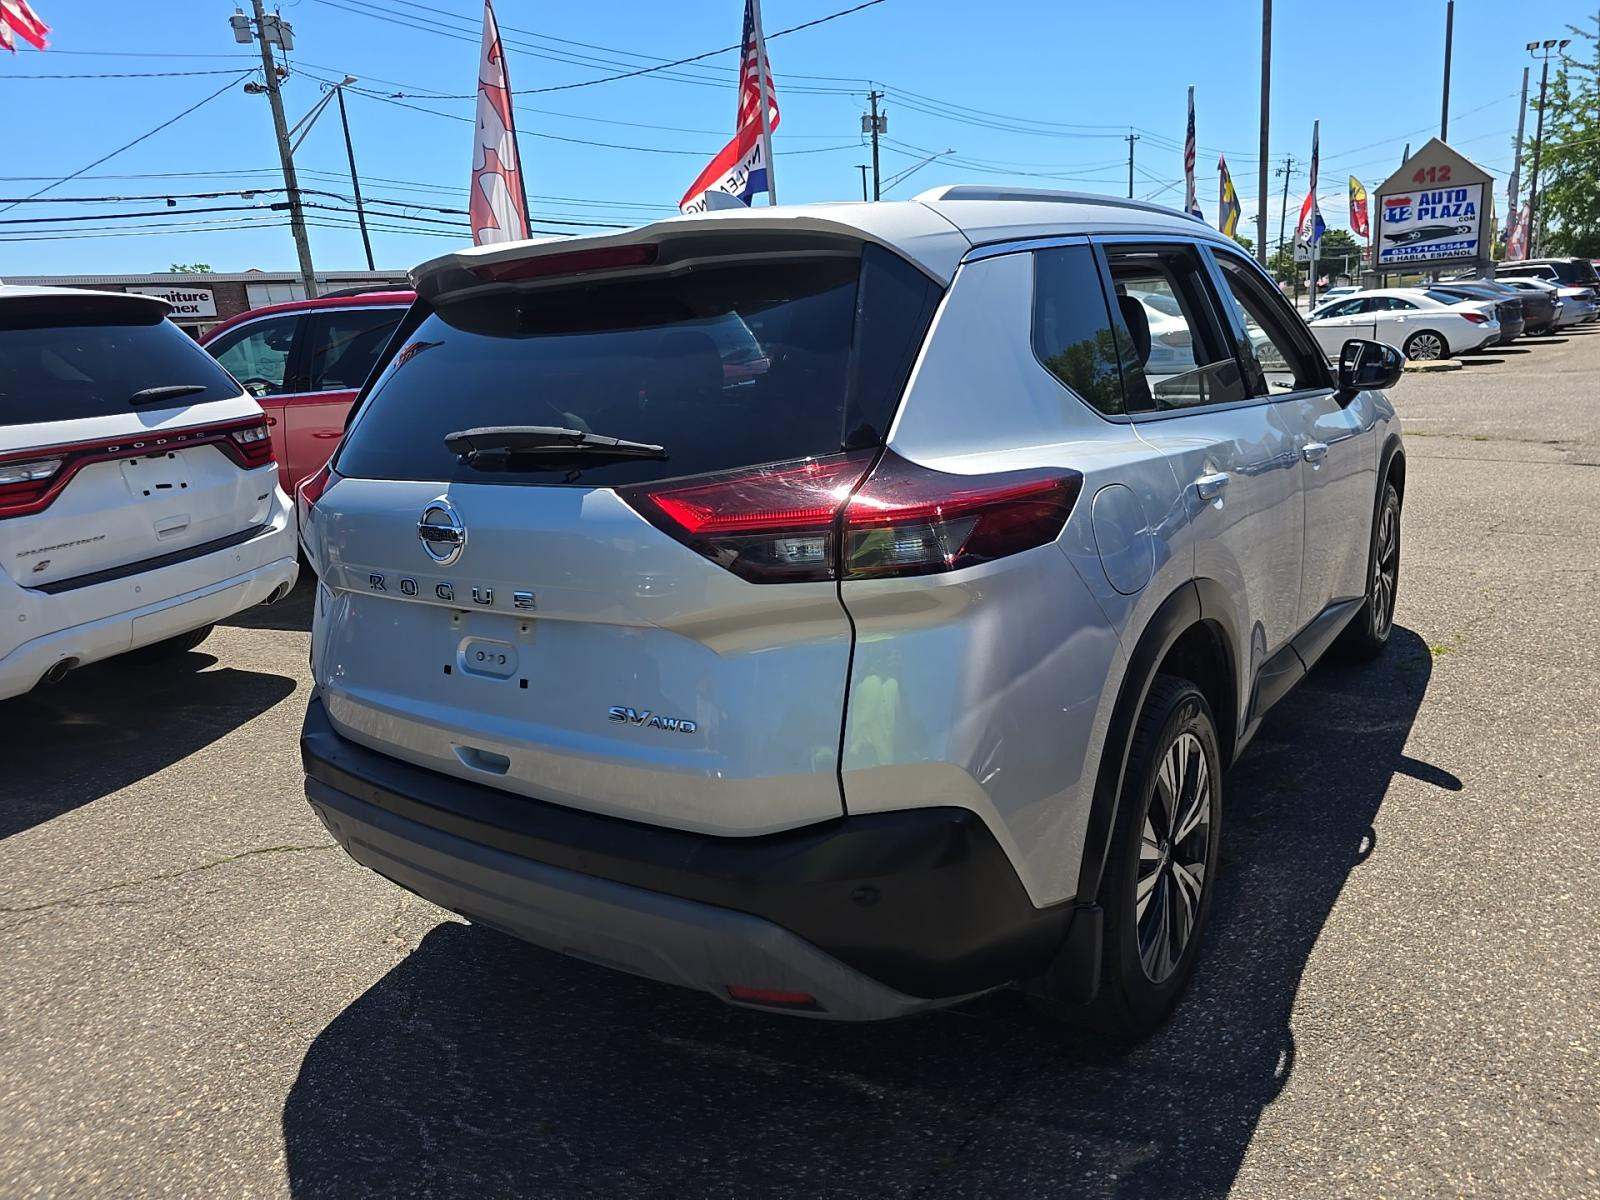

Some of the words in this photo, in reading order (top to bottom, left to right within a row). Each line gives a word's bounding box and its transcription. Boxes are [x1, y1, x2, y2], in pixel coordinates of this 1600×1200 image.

[1412, 165, 1451, 184] 412
[1419, 189, 1467, 206] AUTO
[1383, 207, 1412, 221] 112
[1417, 202, 1475, 220] PLAZA
[1397, 253, 1427, 261] HABLA
[107, 432, 205, 452] DODGE
[369, 572, 536, 611] ROGUE
[608, 705, 650, 726] SV
[647, 715, 697, 734] AWD
